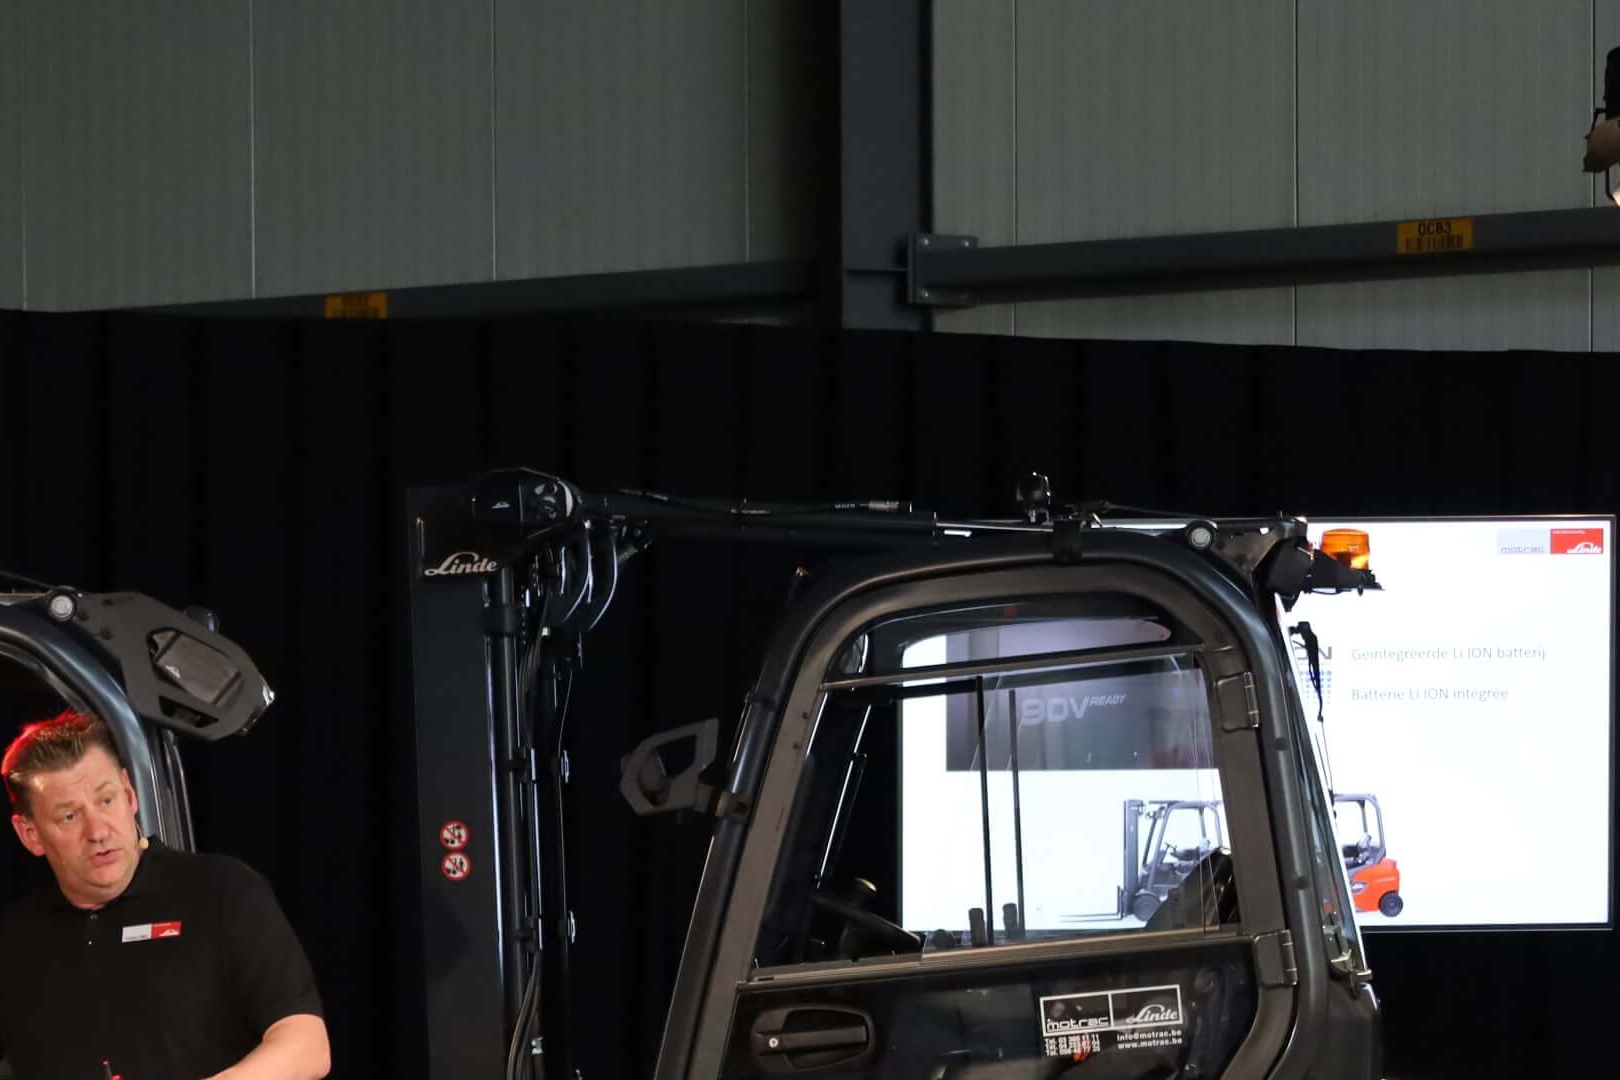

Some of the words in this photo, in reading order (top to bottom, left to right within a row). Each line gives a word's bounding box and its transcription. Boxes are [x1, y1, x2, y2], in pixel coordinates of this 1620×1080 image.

[424, 552, 499, 576] Linde
[1467, 648, 1492, 659] ION
[1497, 647, 1546, 662] batterij
[1352, 688, 1404, 700] Batterie
[1423, 688, 1449, 700] ION
[1126, 1004, 1178, 1024] Linde
[1046, 1017, 1109, 1032] motrac
[1118, 1037, 1183, 1049] www.motrac.be
